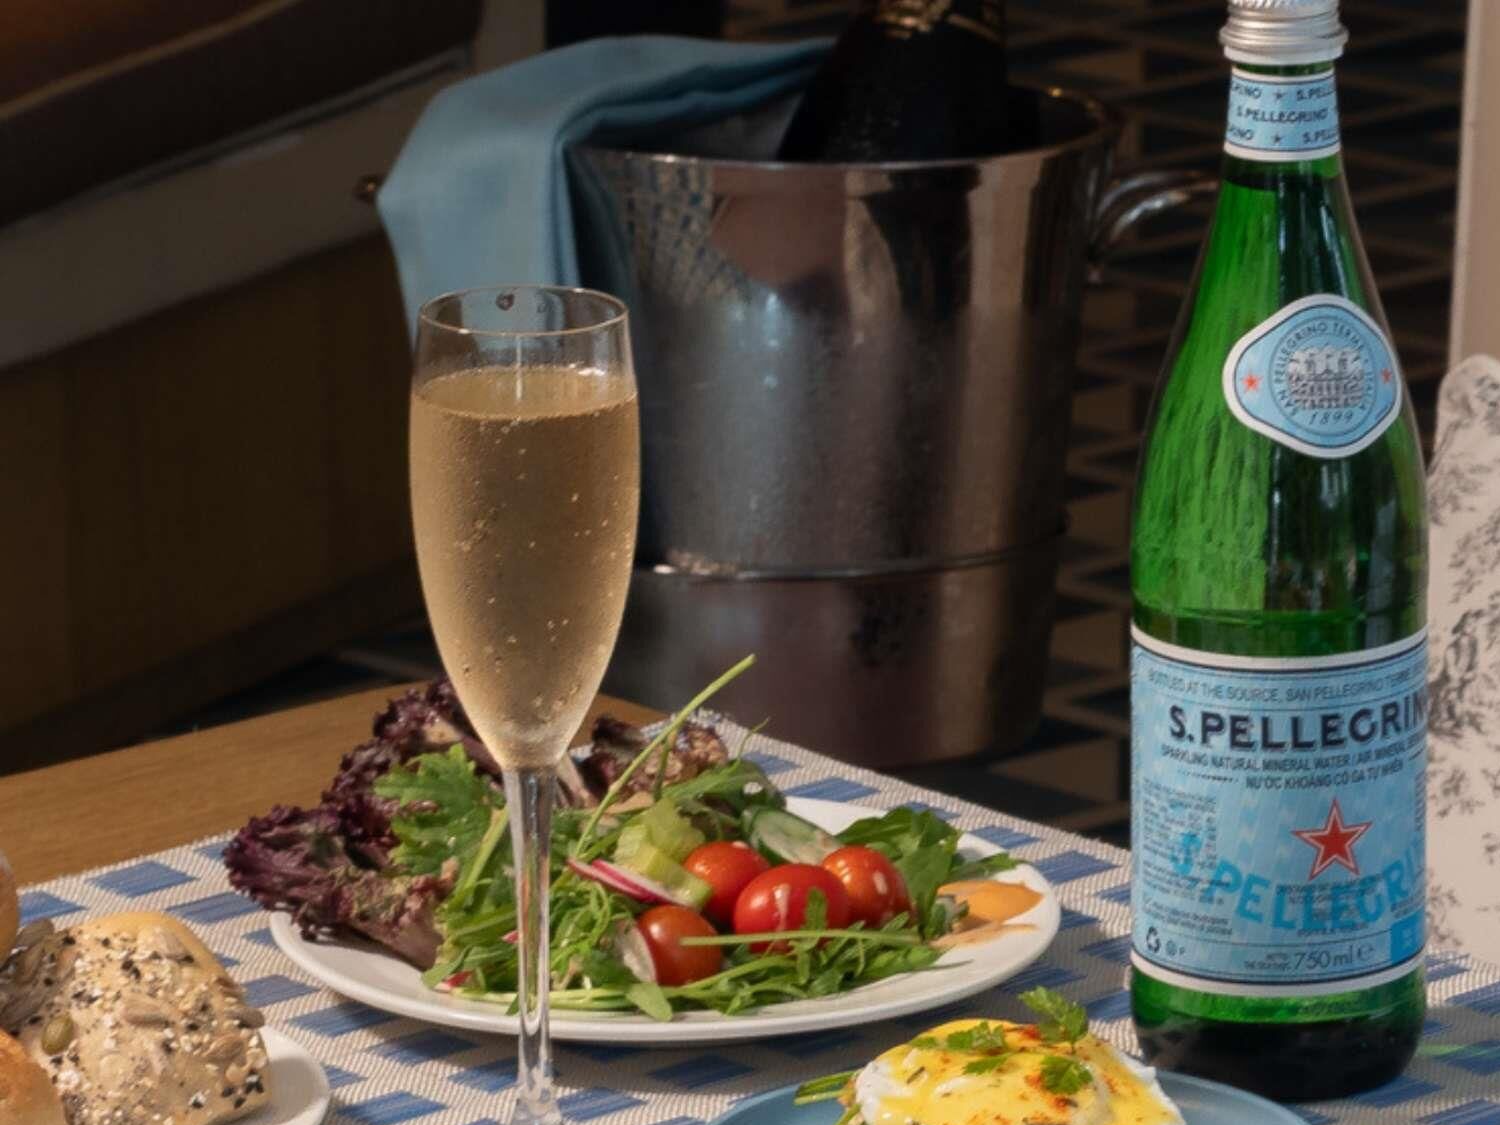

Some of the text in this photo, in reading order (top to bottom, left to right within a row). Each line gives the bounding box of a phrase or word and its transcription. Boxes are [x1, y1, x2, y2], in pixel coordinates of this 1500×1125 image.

[1308, 411, 1354, 426] 1899
[1201, 682, 1223, 698] THE
[1286, 687, 1311, 702] SAN
[1314, 678, 1385, 701] PELLEGRINO
[1211, 754, 1260, 772] NATURAL
[1262, 758, 1311, 773] MINERAL
[1313, 754, 1350, 770] WATER
[1293, 951, 1331, 970] 750
[1332, 945, 1353, 966] ml
